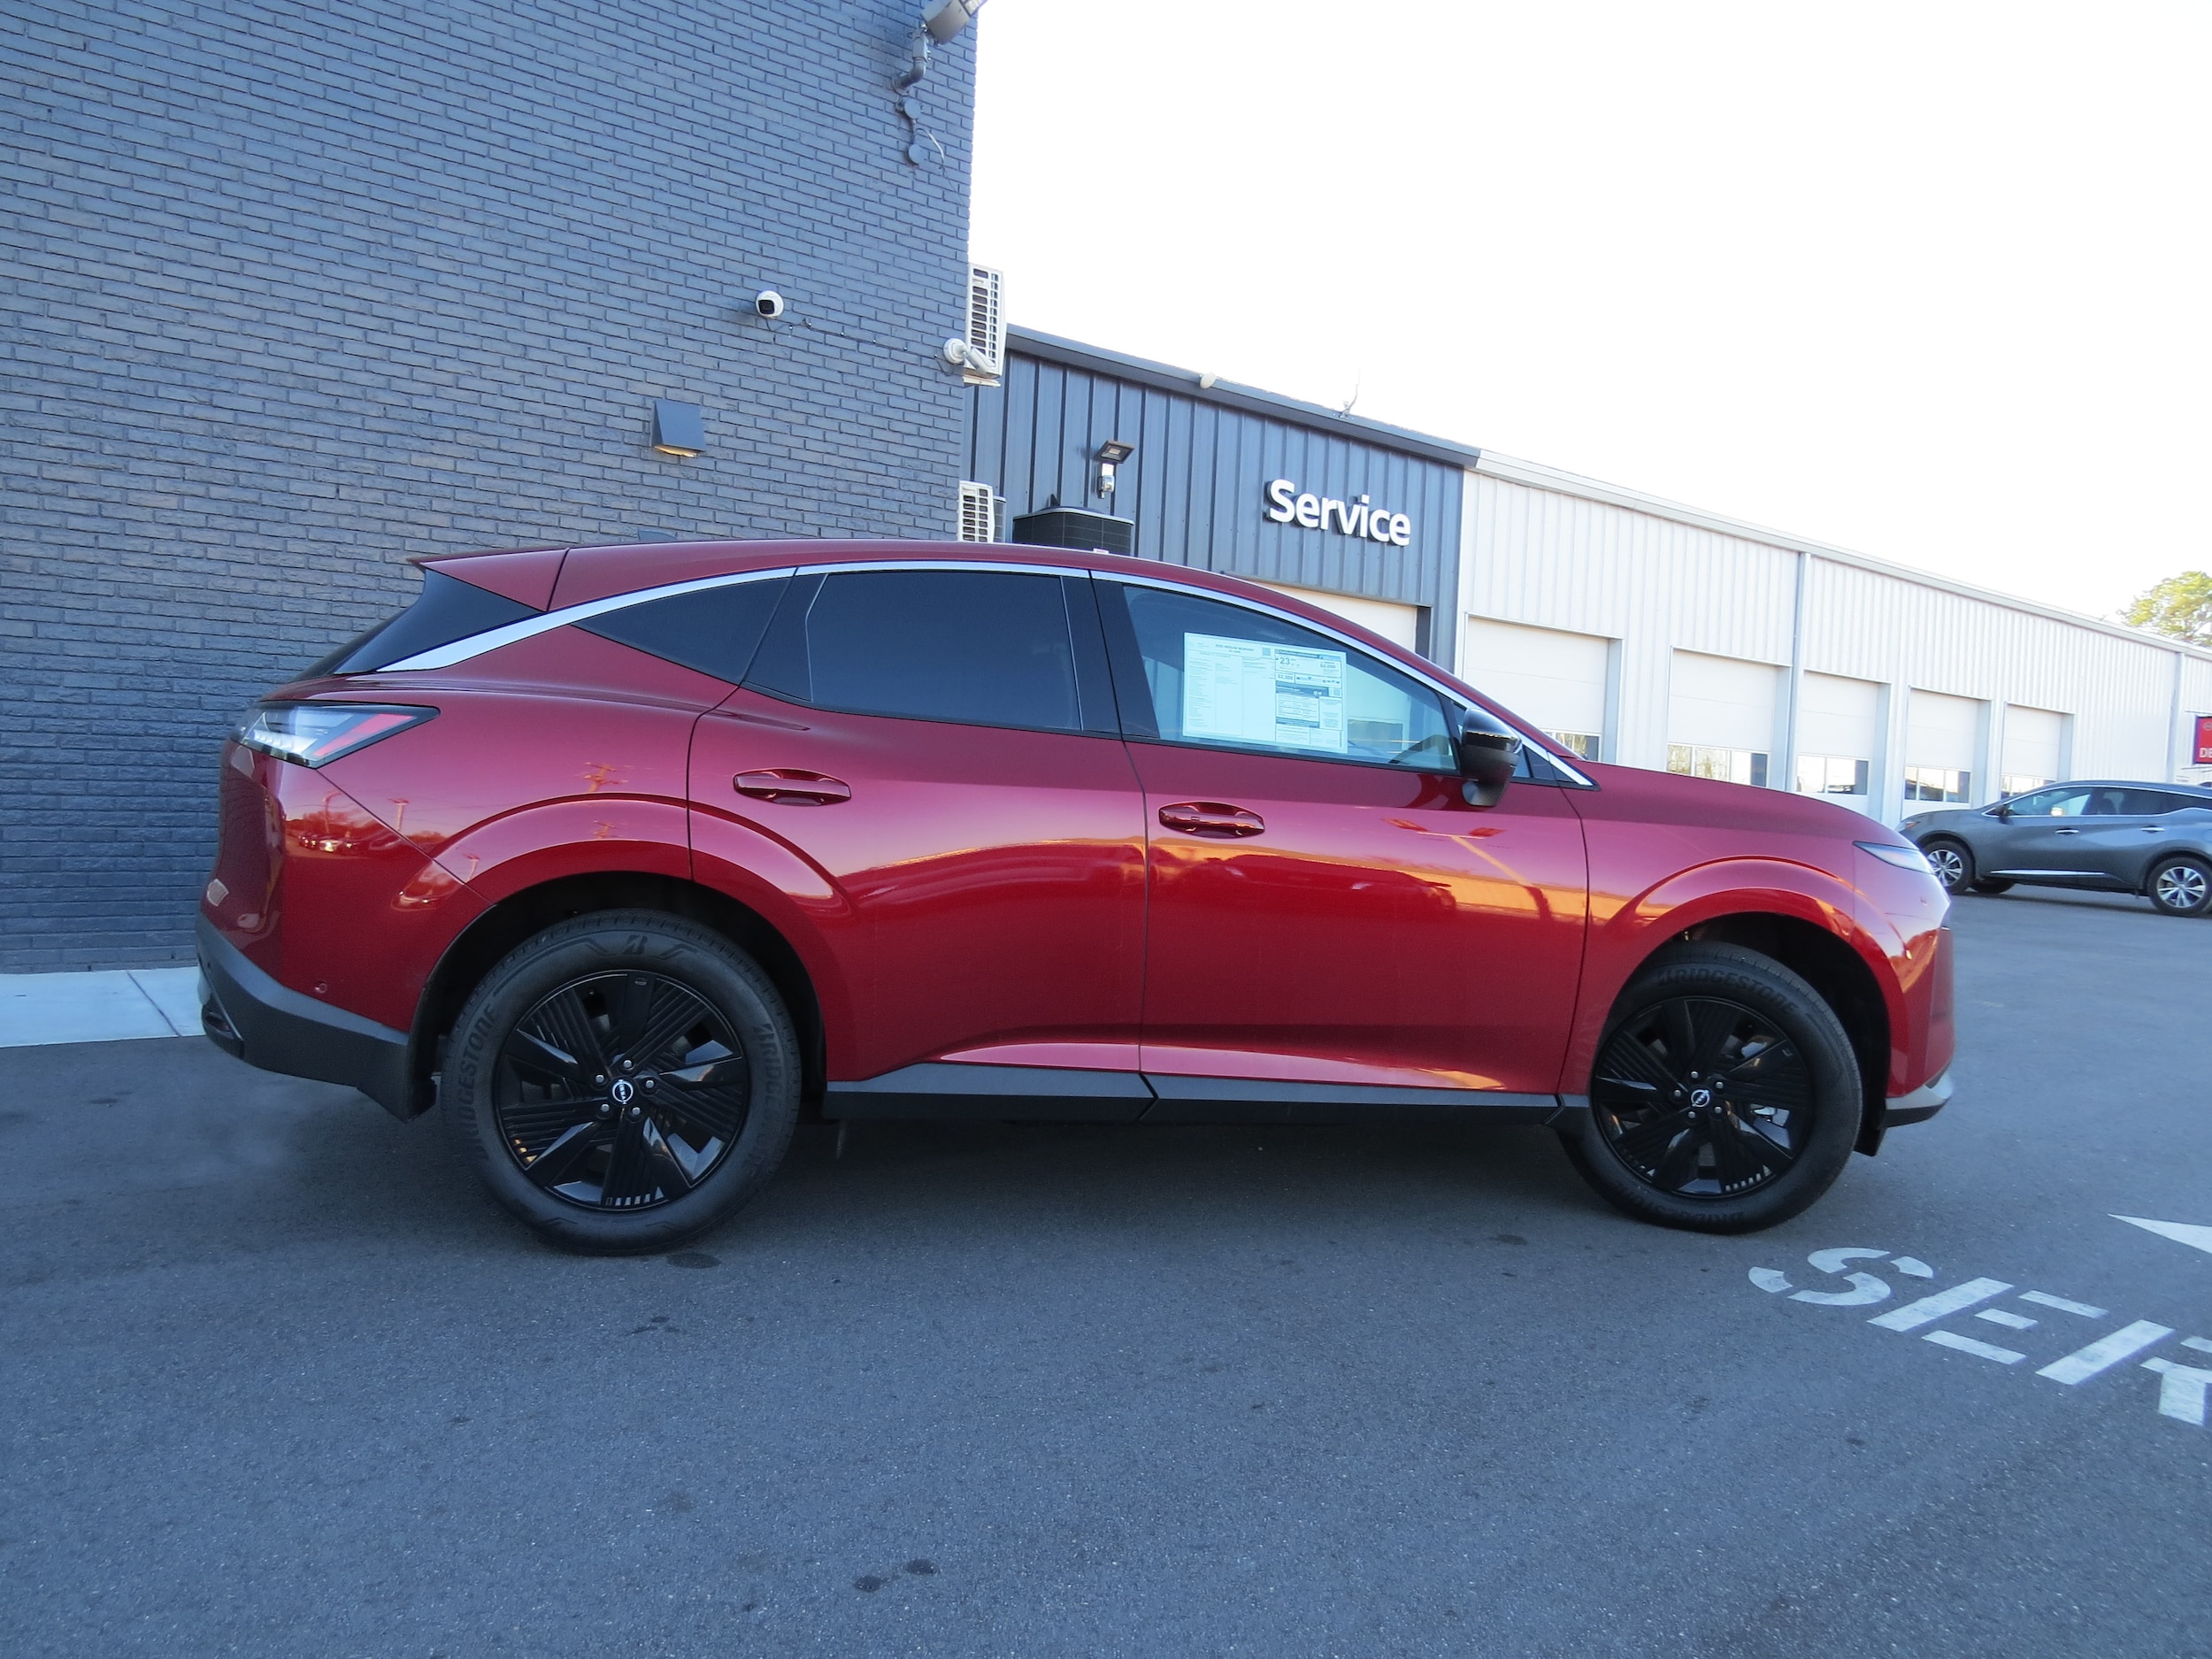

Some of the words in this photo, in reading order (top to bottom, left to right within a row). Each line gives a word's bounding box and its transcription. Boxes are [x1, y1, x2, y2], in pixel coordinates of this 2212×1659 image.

[1266, 478, 1412, 547] Service
[1657, 967, 1801, 1014] BRIDGESTONE
[456, 1001, 497, 1161] BRIDGESTONE
